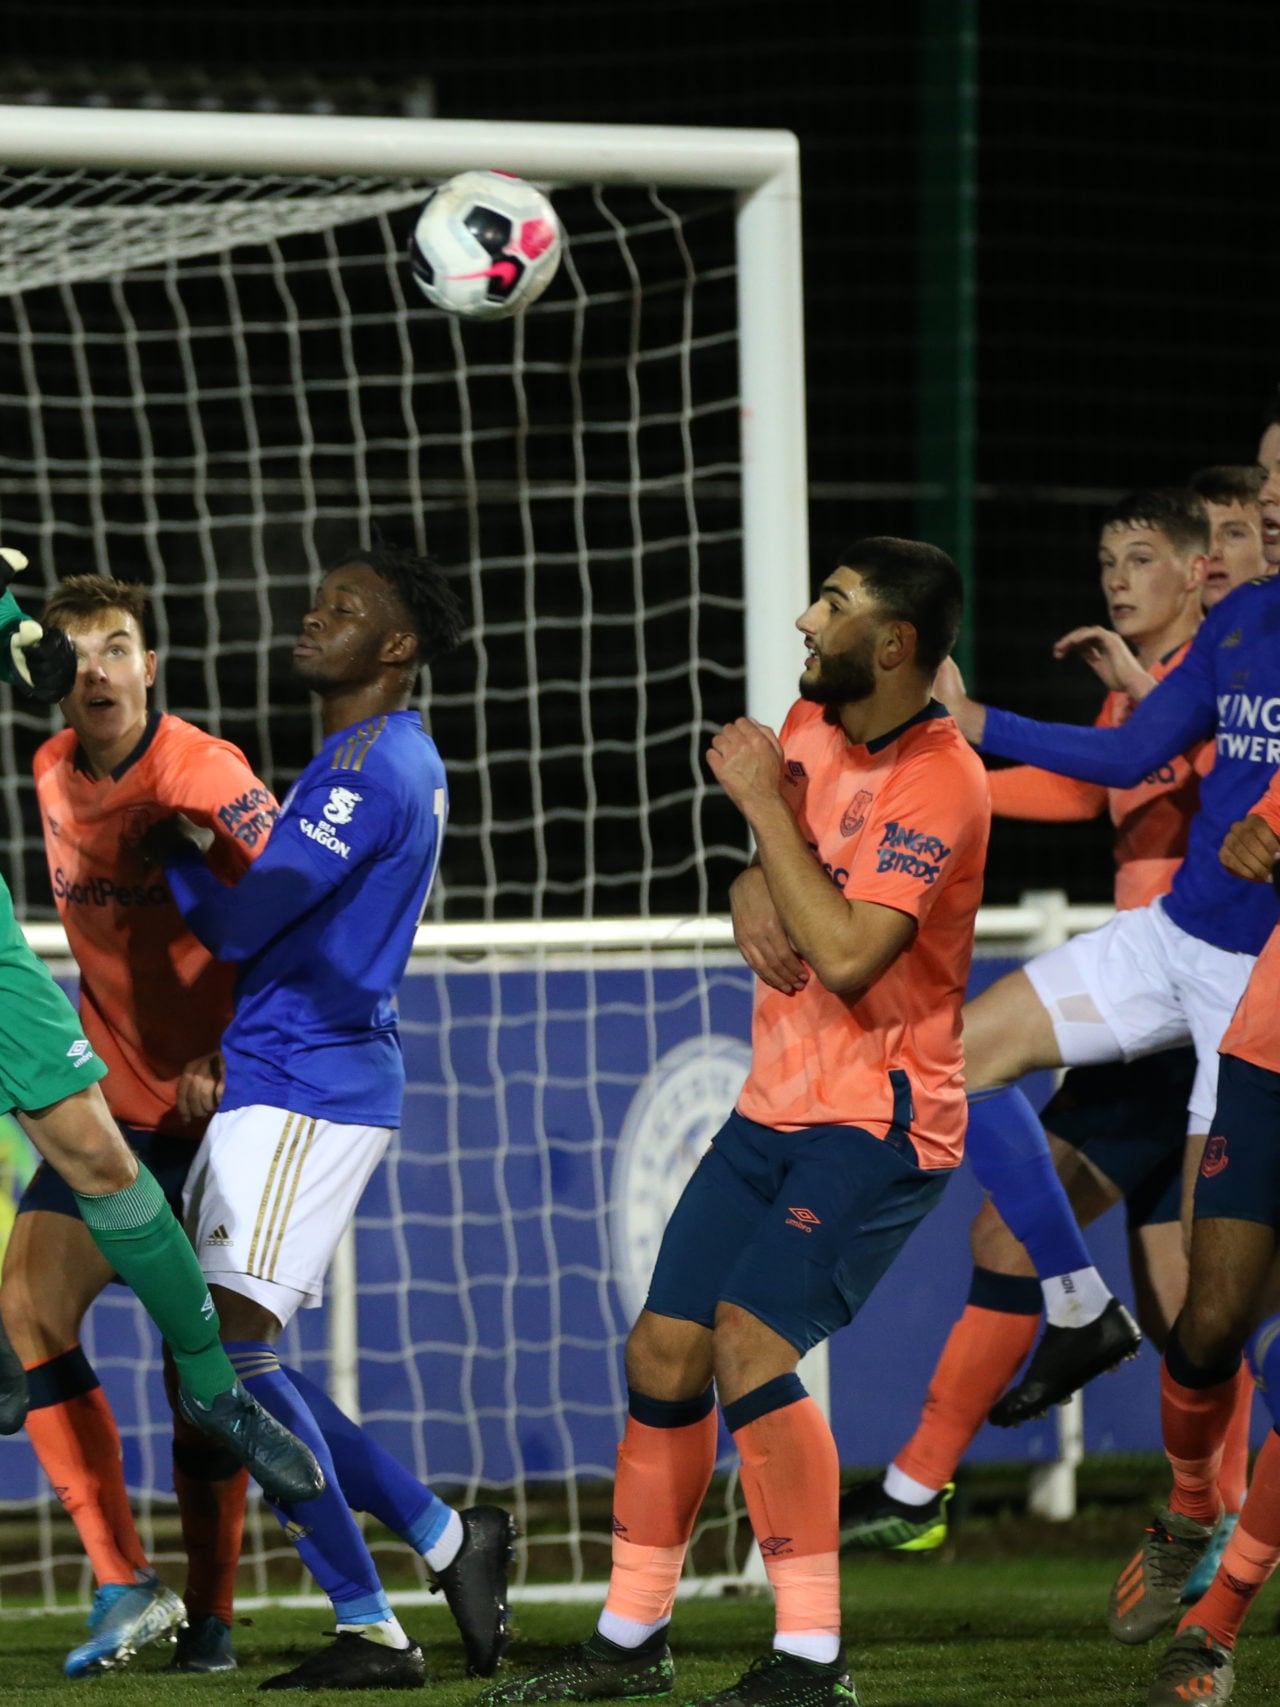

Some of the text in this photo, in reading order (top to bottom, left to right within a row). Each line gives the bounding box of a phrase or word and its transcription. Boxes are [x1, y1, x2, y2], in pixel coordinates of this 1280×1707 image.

[218, 788, 272, 832] ANGRY
[235, 806, 279, 849] BIR
[318, 820, 337, 836] BIA
[300, 818, 351, 860] SAIGON
[879, 822, 951, 863] ANGRY
[876, 849, 941, 885] BIRDS
